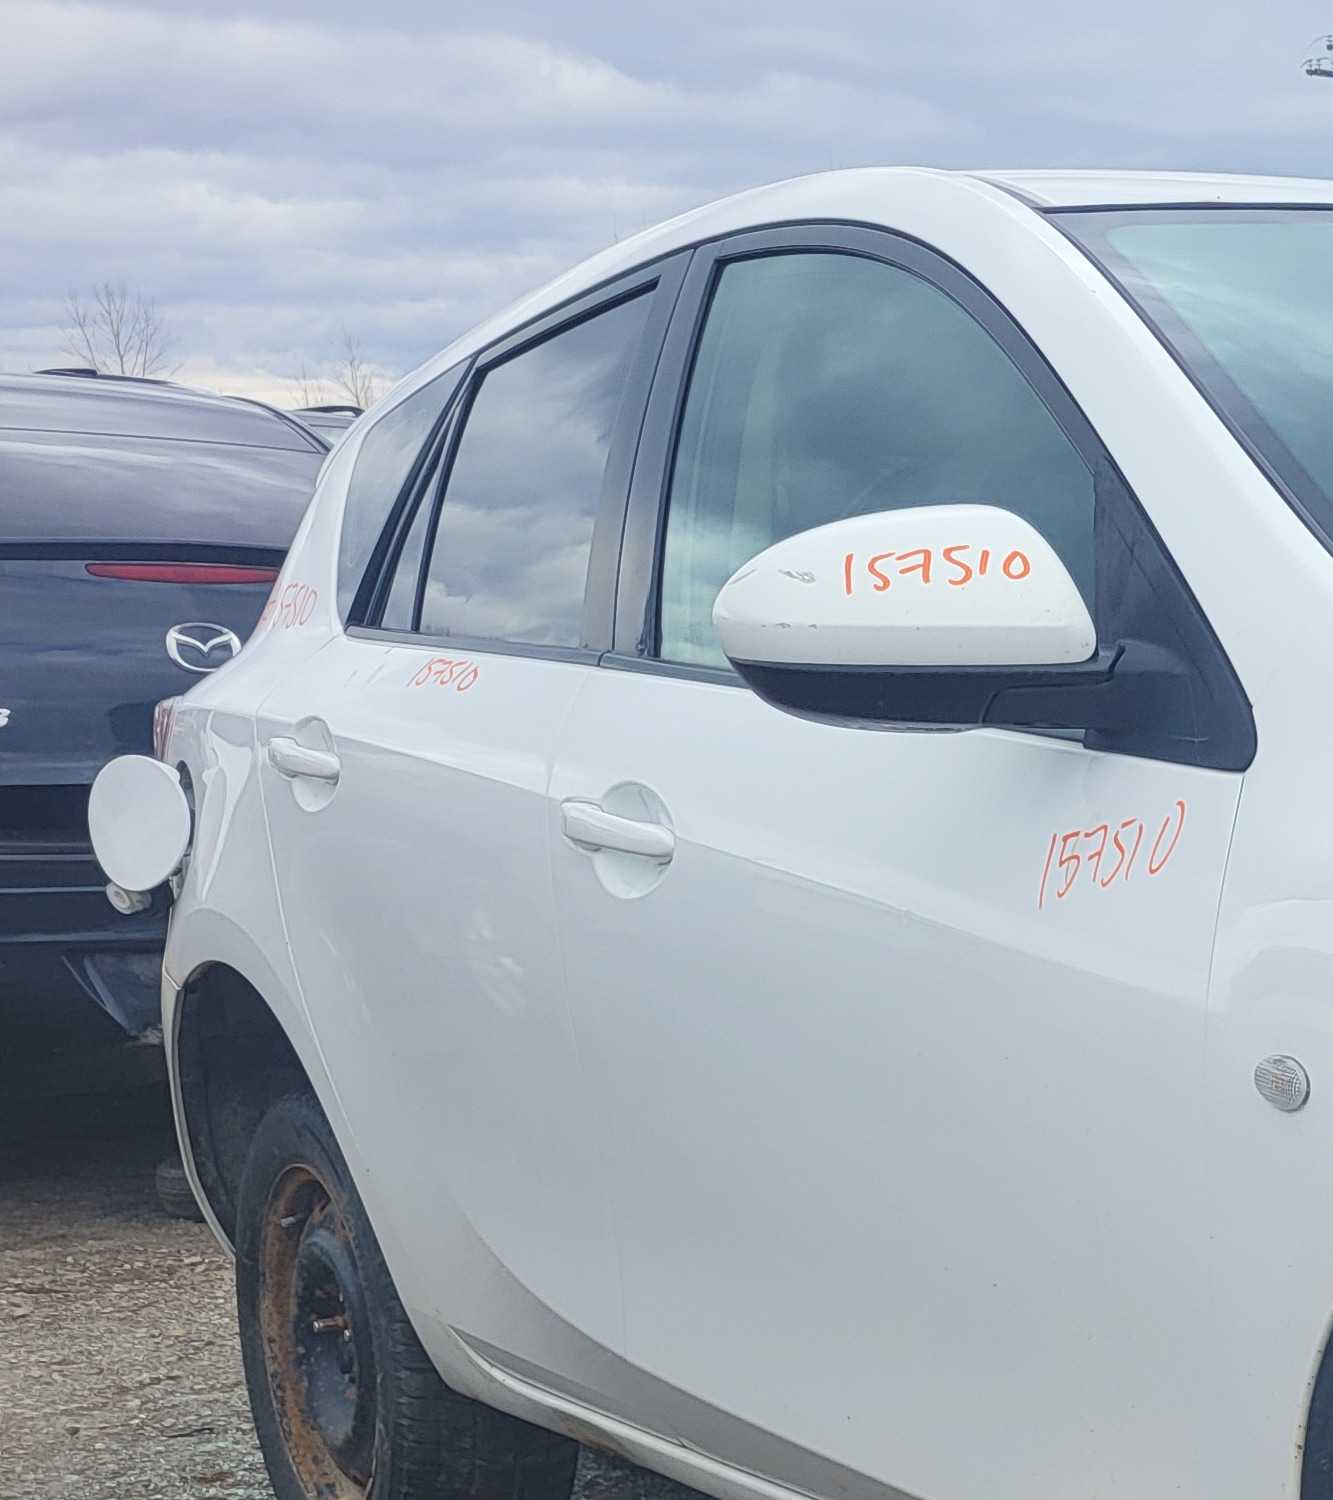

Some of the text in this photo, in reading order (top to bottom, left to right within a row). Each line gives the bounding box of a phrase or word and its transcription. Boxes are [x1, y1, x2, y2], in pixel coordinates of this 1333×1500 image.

[843, 544, 1031, 595] 157510
[406, 657, 479, 692] 157510
[1039, 800, 1186, 910] 157510
